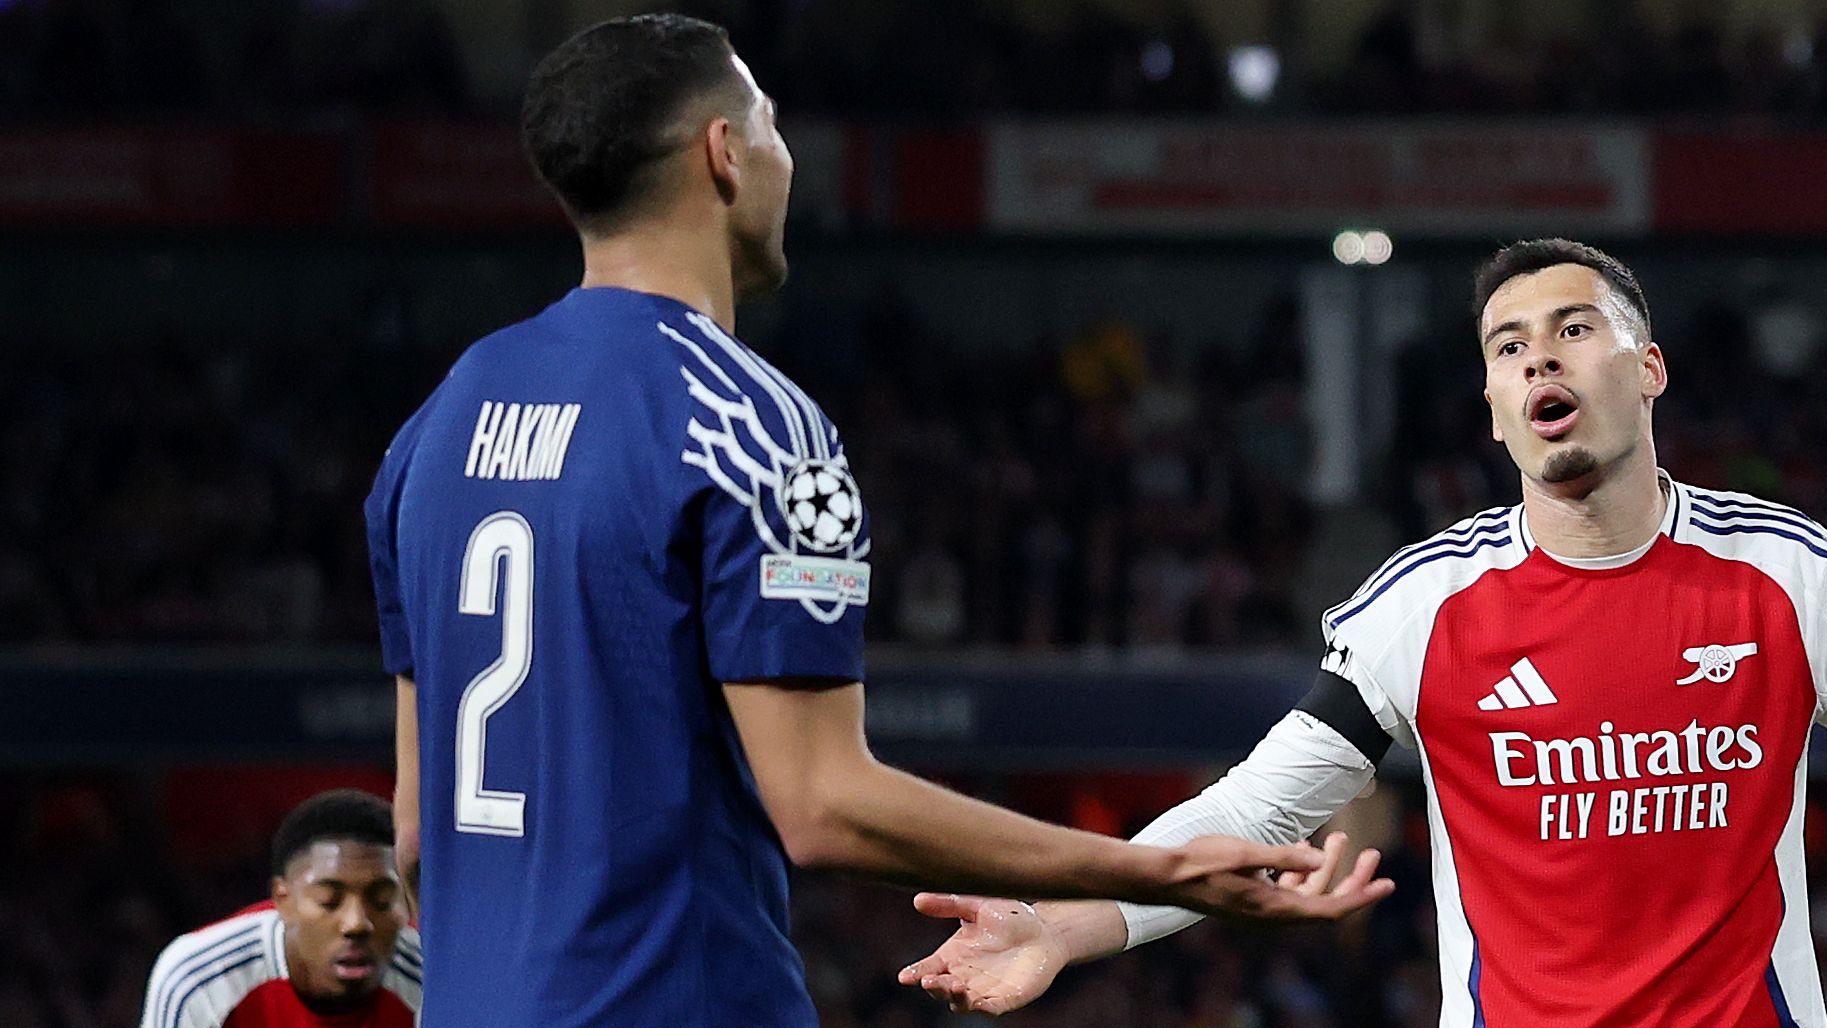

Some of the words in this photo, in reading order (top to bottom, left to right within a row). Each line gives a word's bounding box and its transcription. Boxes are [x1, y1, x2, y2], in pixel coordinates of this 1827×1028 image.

[464, 400, 582, 481] HAKIMI
[455, 510, 534, 838] 2
[1488, 719, 1763, 786] Emirates
[1540, 792, 1596, 840] FLY
[1607, 782, 1728, 837] BETTER
